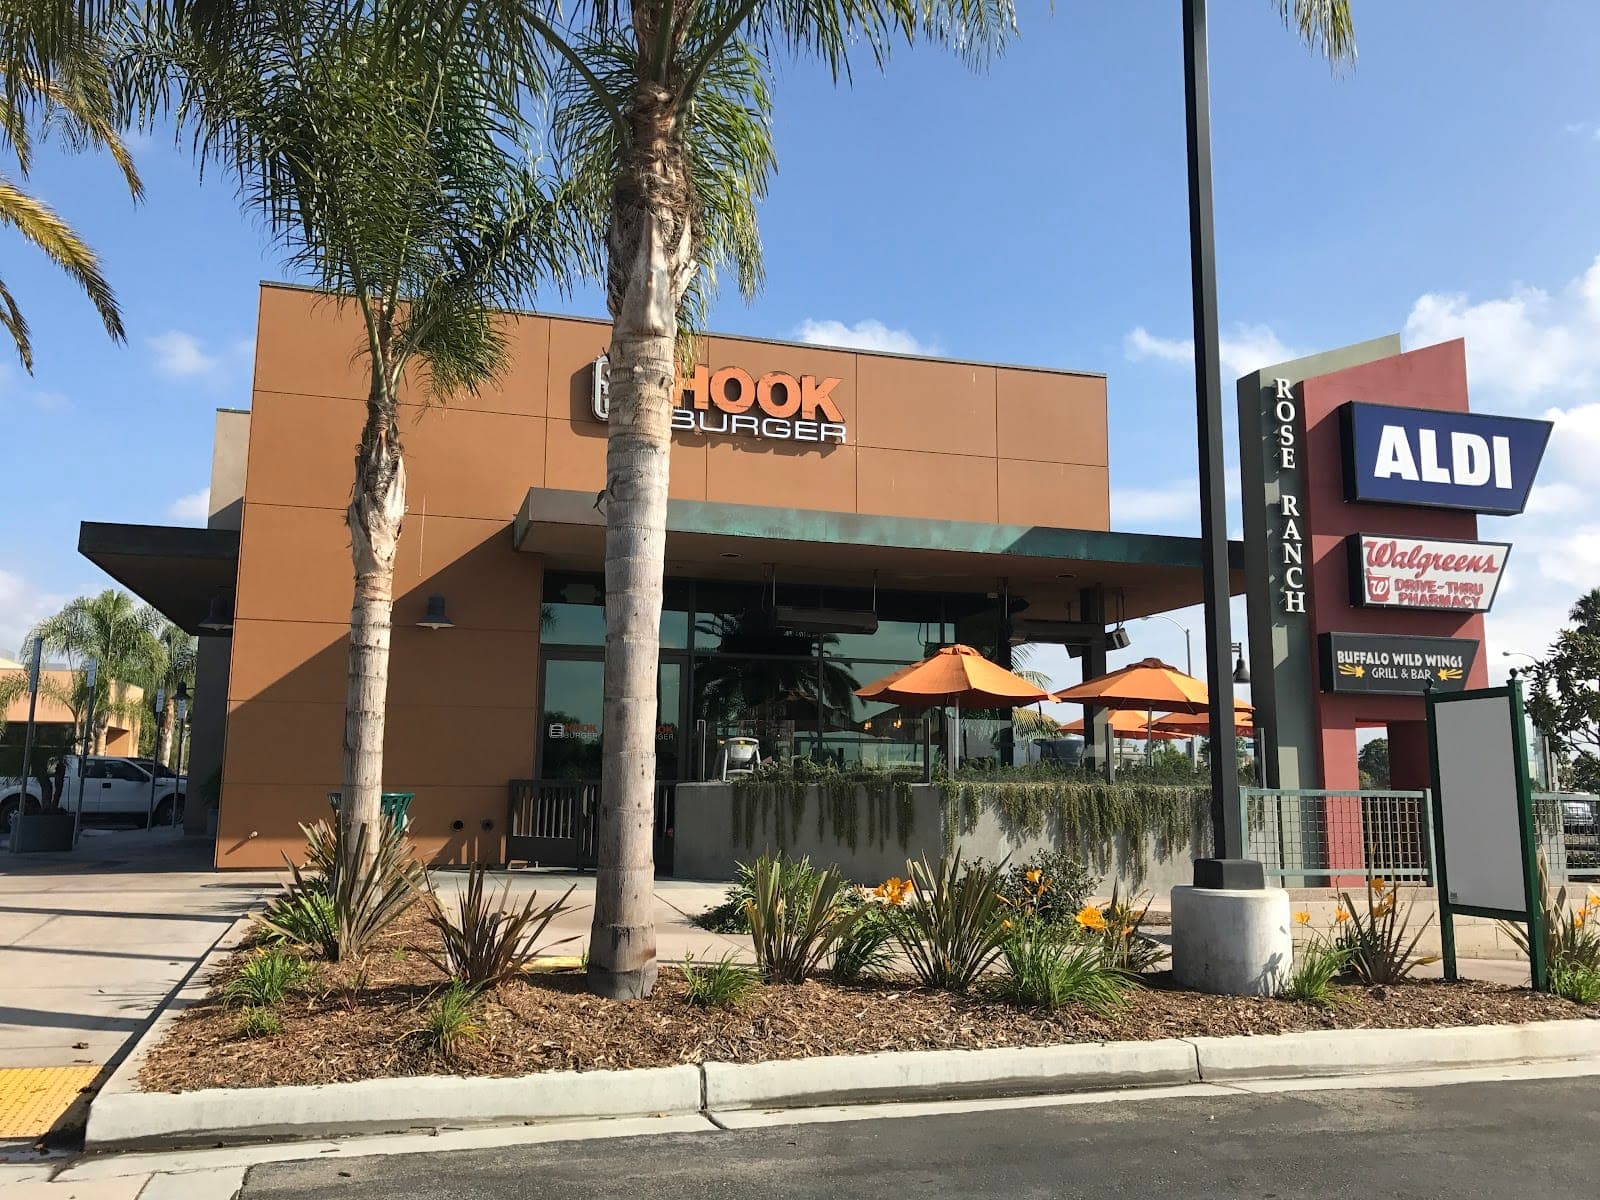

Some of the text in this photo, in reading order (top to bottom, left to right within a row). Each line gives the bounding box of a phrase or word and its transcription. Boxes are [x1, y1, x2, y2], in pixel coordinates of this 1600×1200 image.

[673, 362, 845, 422] HOOK
[671, 409, 847, 443] BURGER
[1374, 425, 1513, 489] ALDI
[1275, 378, 1306, 613] ROSE RANCH
[1364, 541, 1499, 578] Walgreens
[1399, 593, 1480, 608] PHARMACY
[1337, 651, 1463, 668] BUFFALO WILD WINGS
[1371, 667, 1431, 680] GRILL & BAR
